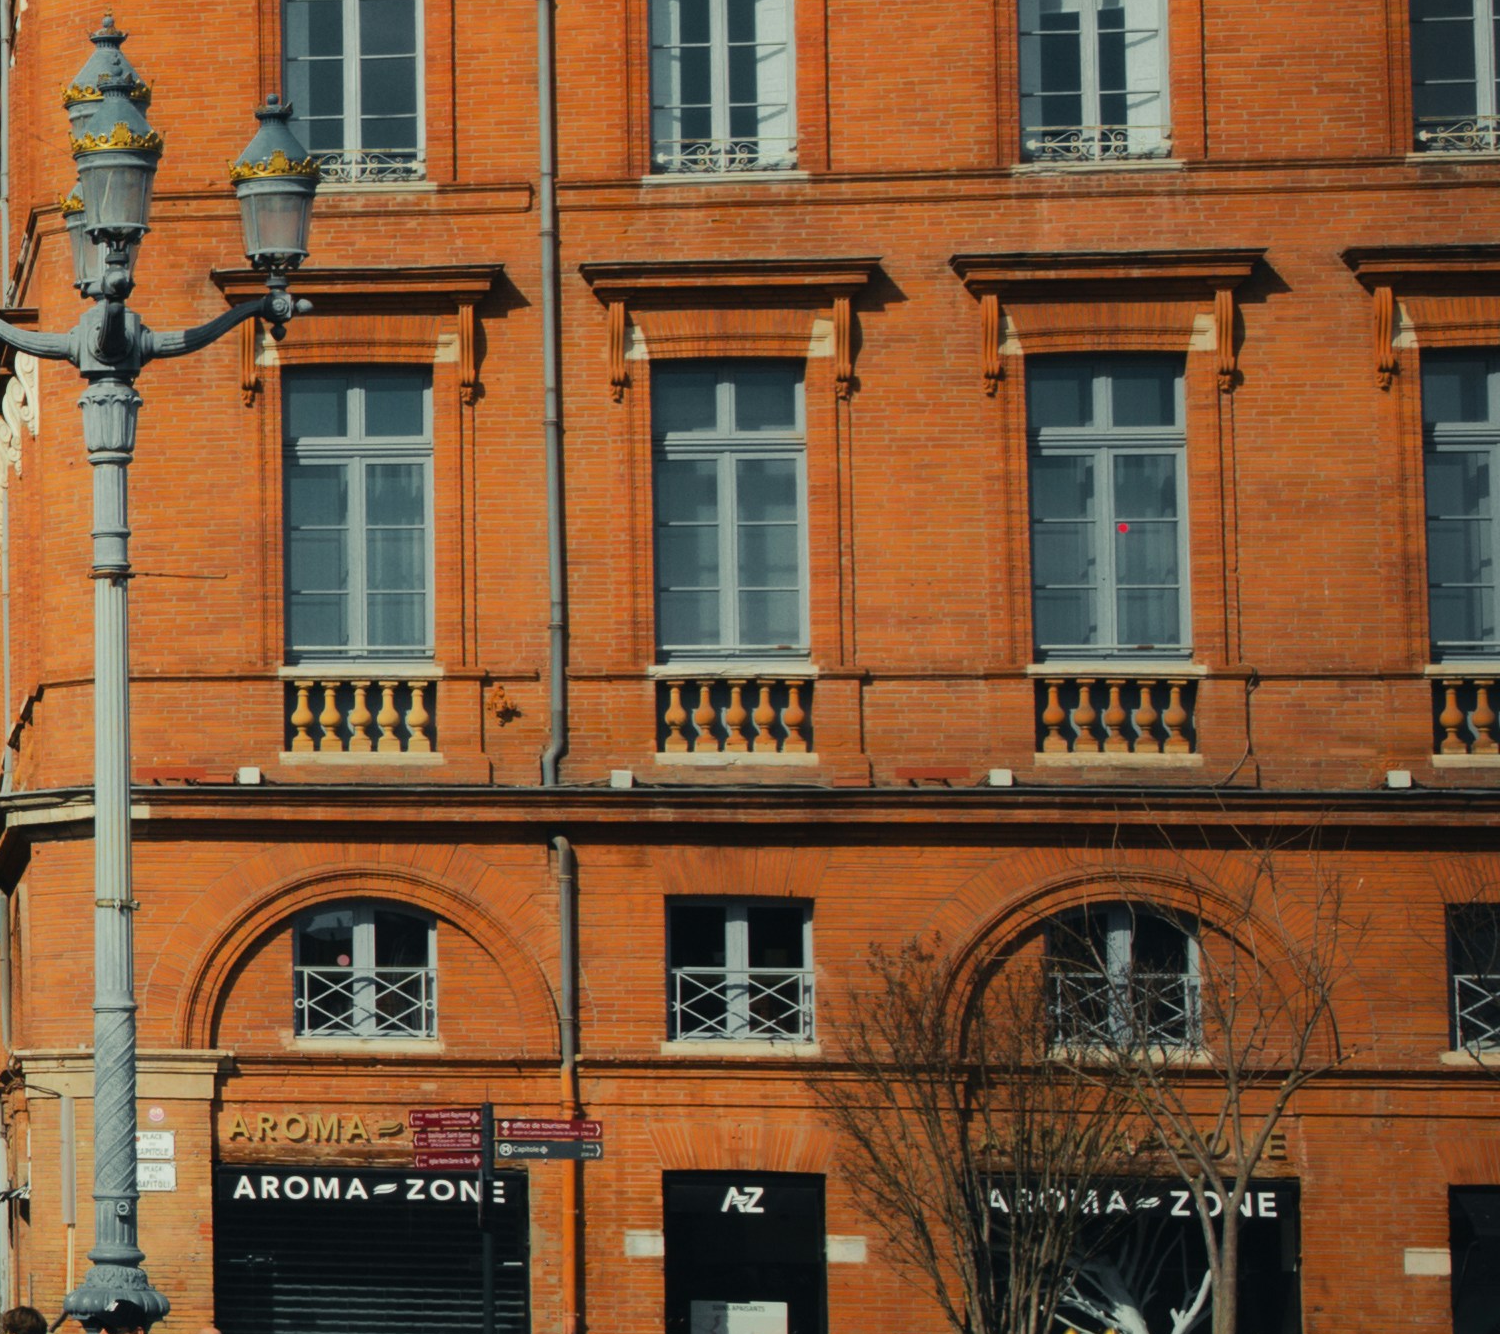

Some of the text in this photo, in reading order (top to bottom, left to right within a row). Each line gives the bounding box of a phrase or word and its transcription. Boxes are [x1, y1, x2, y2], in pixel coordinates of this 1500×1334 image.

[228, 1113, 370, 1142] AROMA
[513, 1146, 540, 1154] Capitole
[233, 1175, 505, 1203] AROMA ZONE
[1170, 1190, 1277, 1217] ZONE
